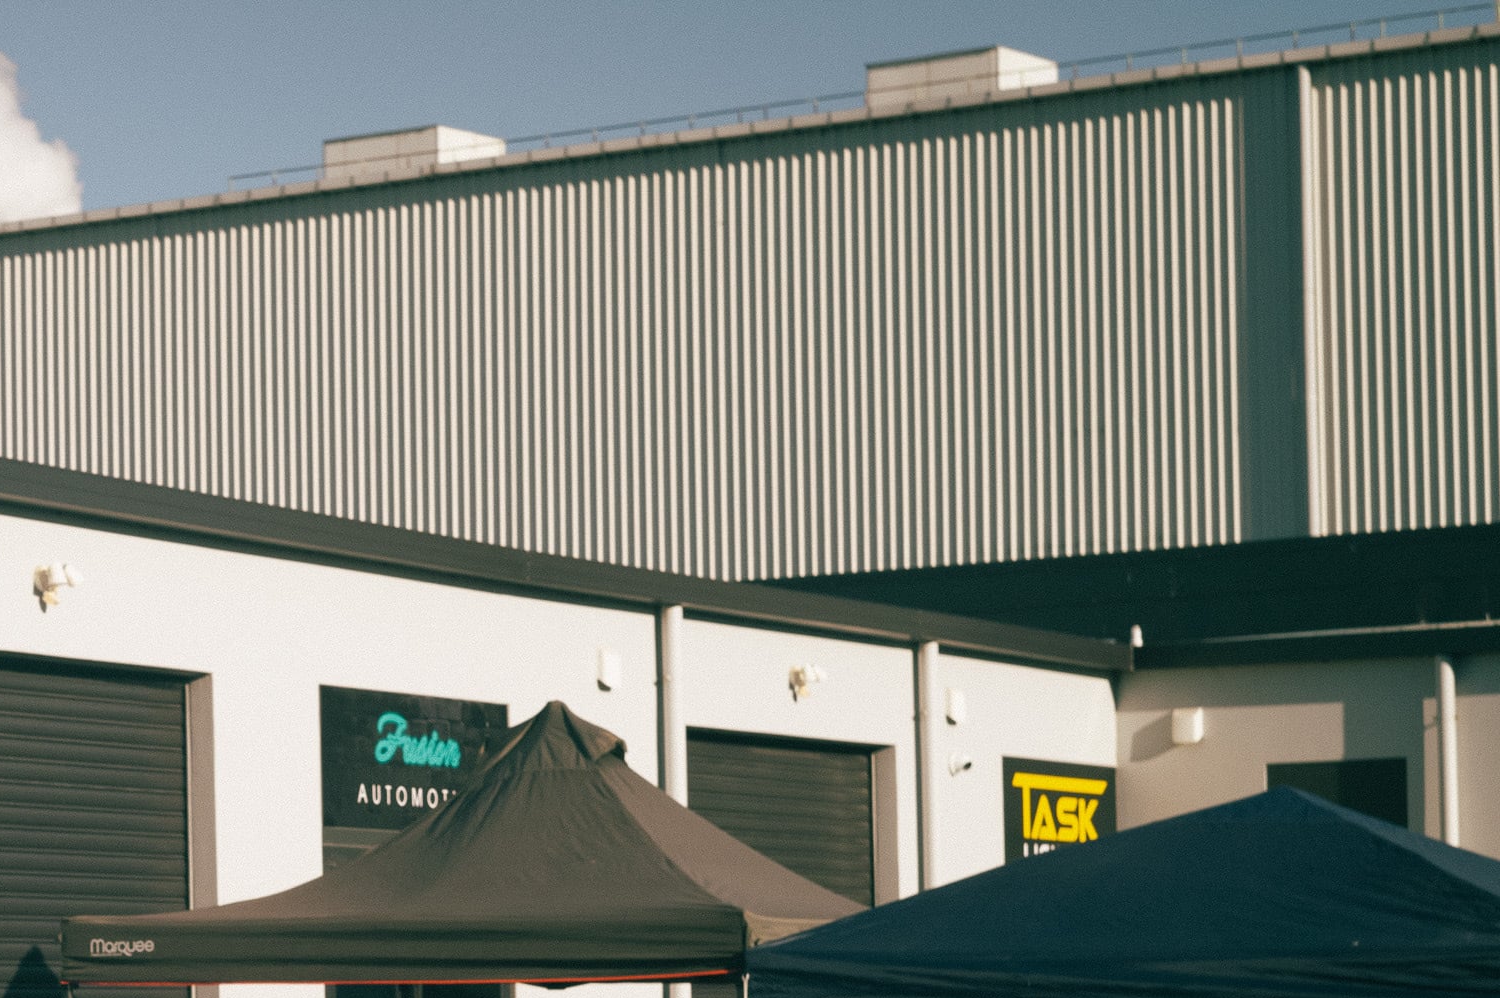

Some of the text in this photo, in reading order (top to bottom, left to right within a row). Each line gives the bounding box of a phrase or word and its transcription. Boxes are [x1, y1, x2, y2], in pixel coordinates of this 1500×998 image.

[373, 711, 462, 768] Fusion
[356, 782, 456, 810] AUTOMOT
[1011, 771, 1109, 844] TASK
